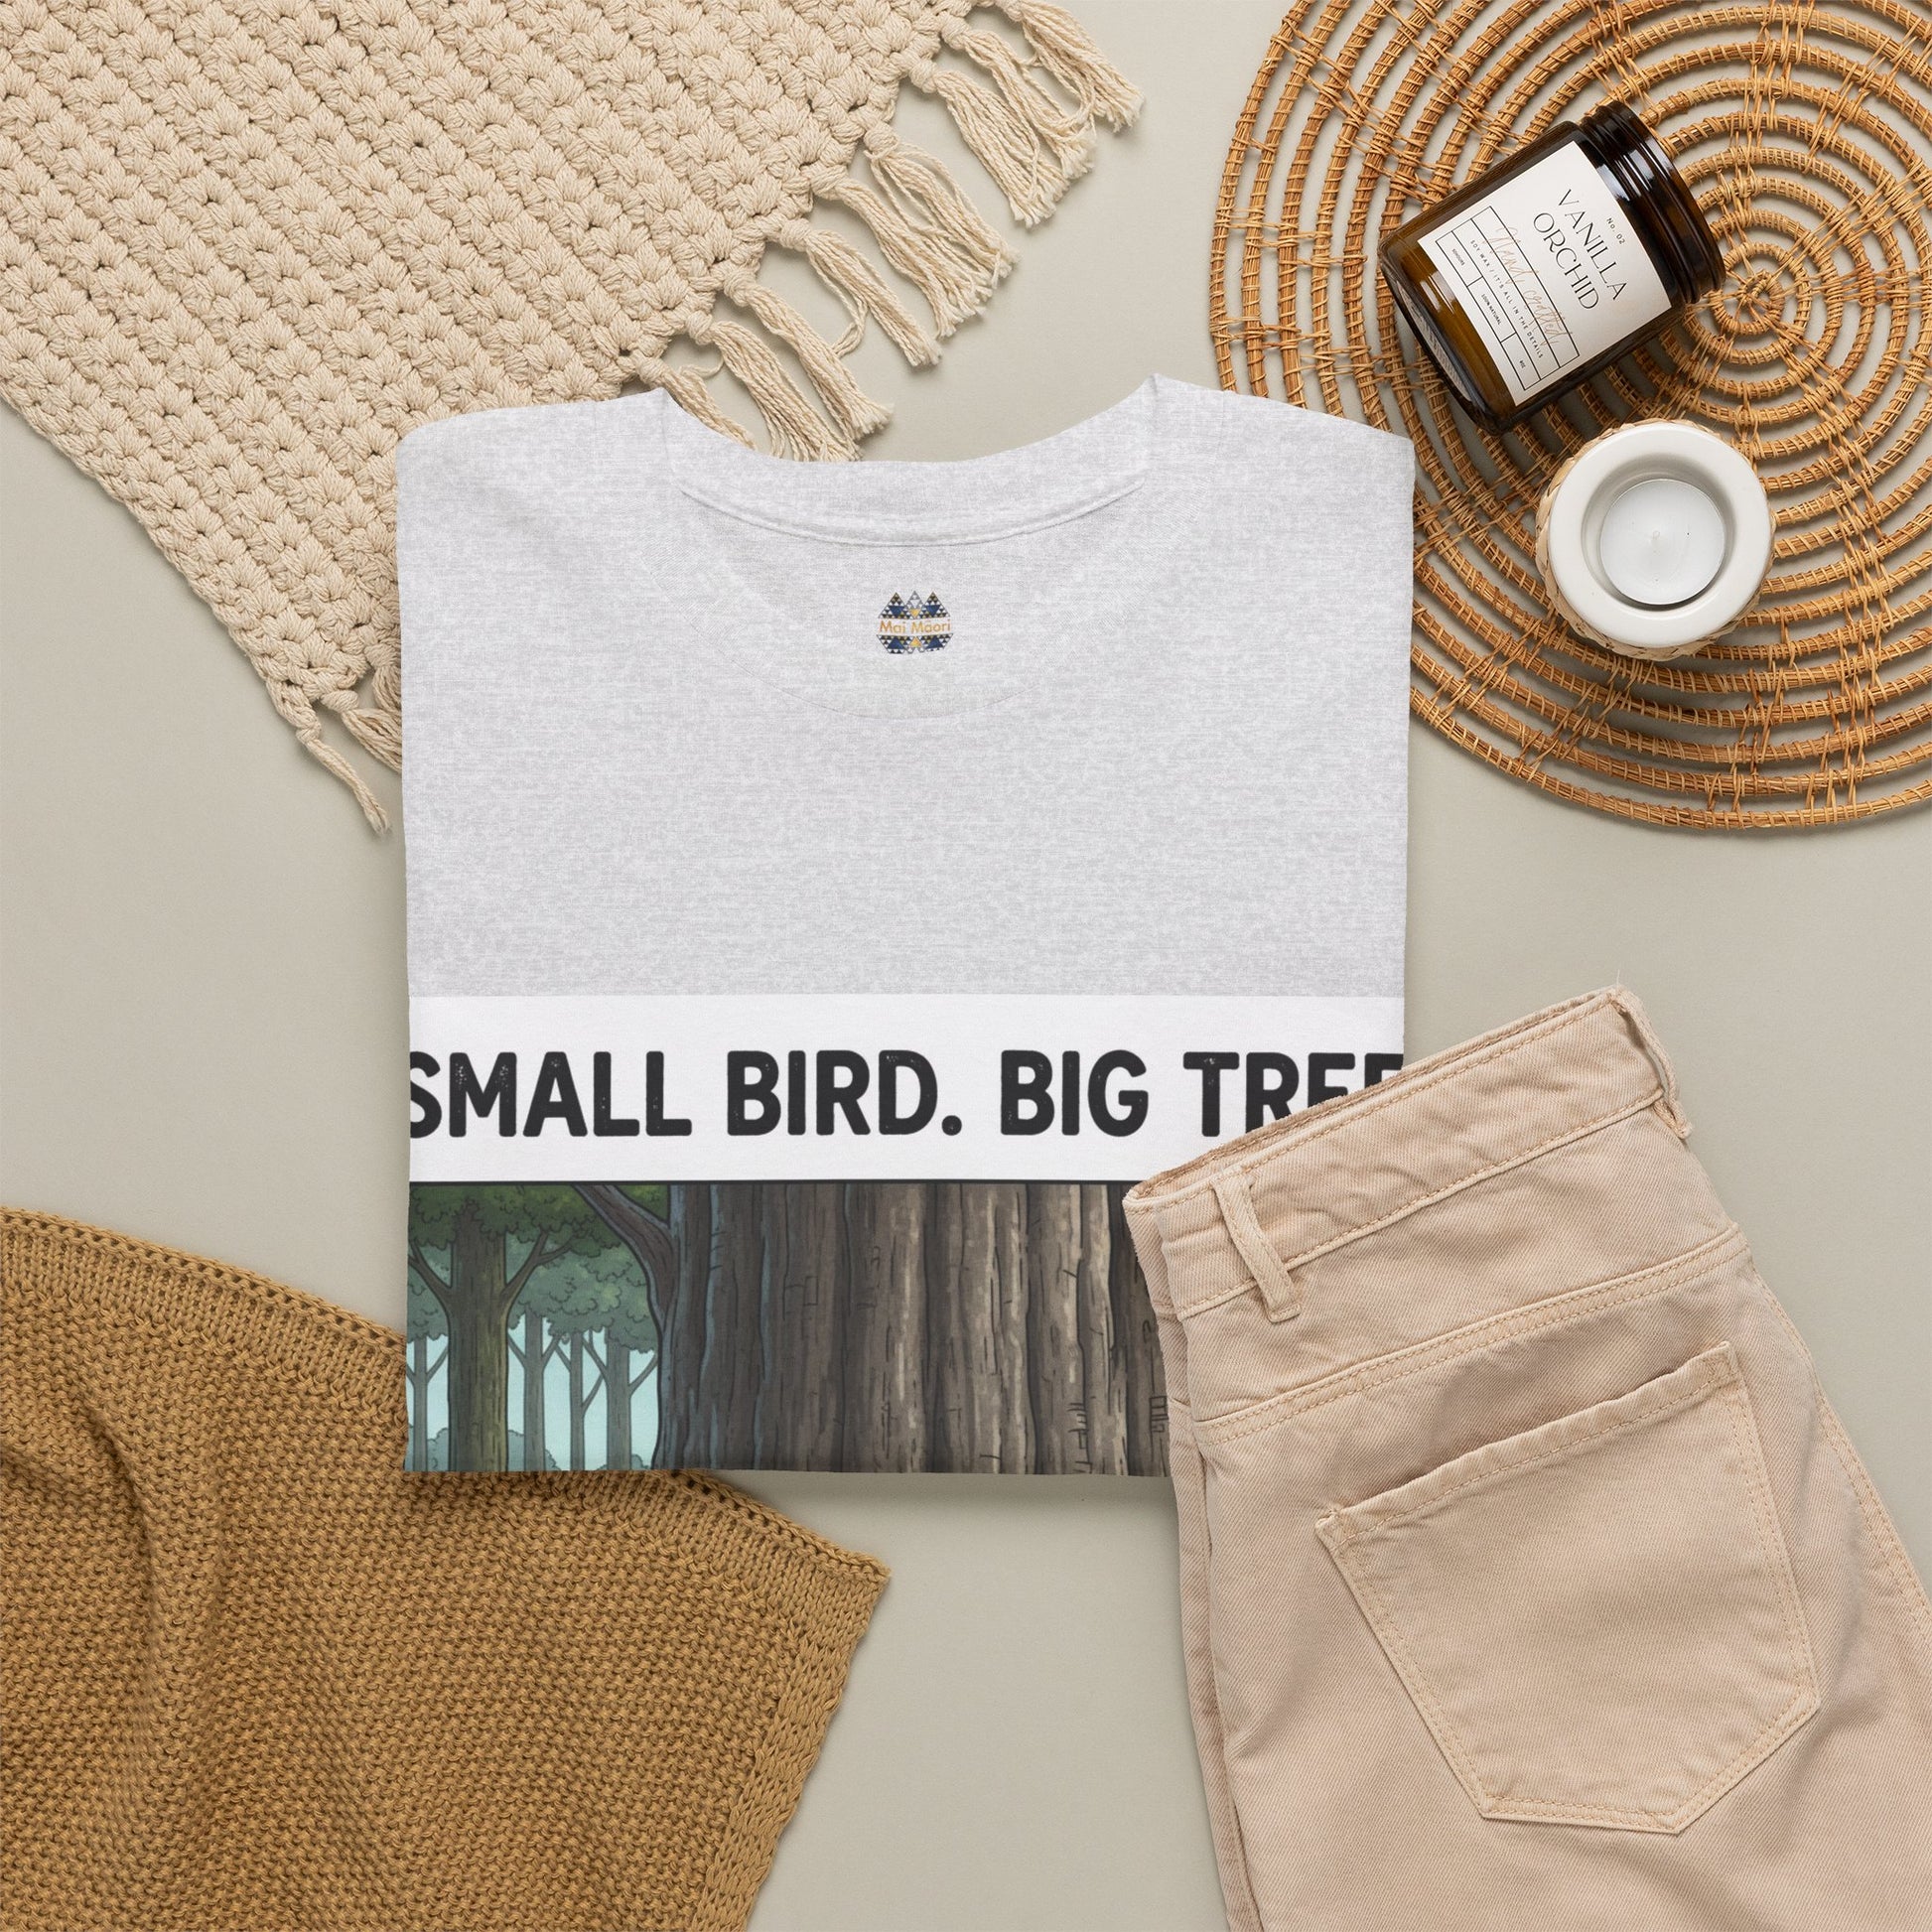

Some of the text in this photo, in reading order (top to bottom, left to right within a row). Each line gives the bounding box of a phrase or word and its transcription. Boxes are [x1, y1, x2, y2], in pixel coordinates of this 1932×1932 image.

[1534, 212, 1599, 310] ORCHID
[1559, 189, 1627, 301] VANILLA
[1606, 217, 1625, 245] No. 02
[1470, 240, 1480, 251] SOY
[1480, 253, 1490, 267] WAX
[1493, 274, 1504, 289] IT'S
[1503, 291, 1513, 304] ALL
[1519, 317, 1529, 330] THE
[1527, 332, 1546, 358] DETAILS
[880, 621, 905, 633] Mai
[410, 1050, 692, 1139] SMALL
[727, 1049, 962, 1136] BIRD.
[1001, 1049, 1149, 1137] BIG
